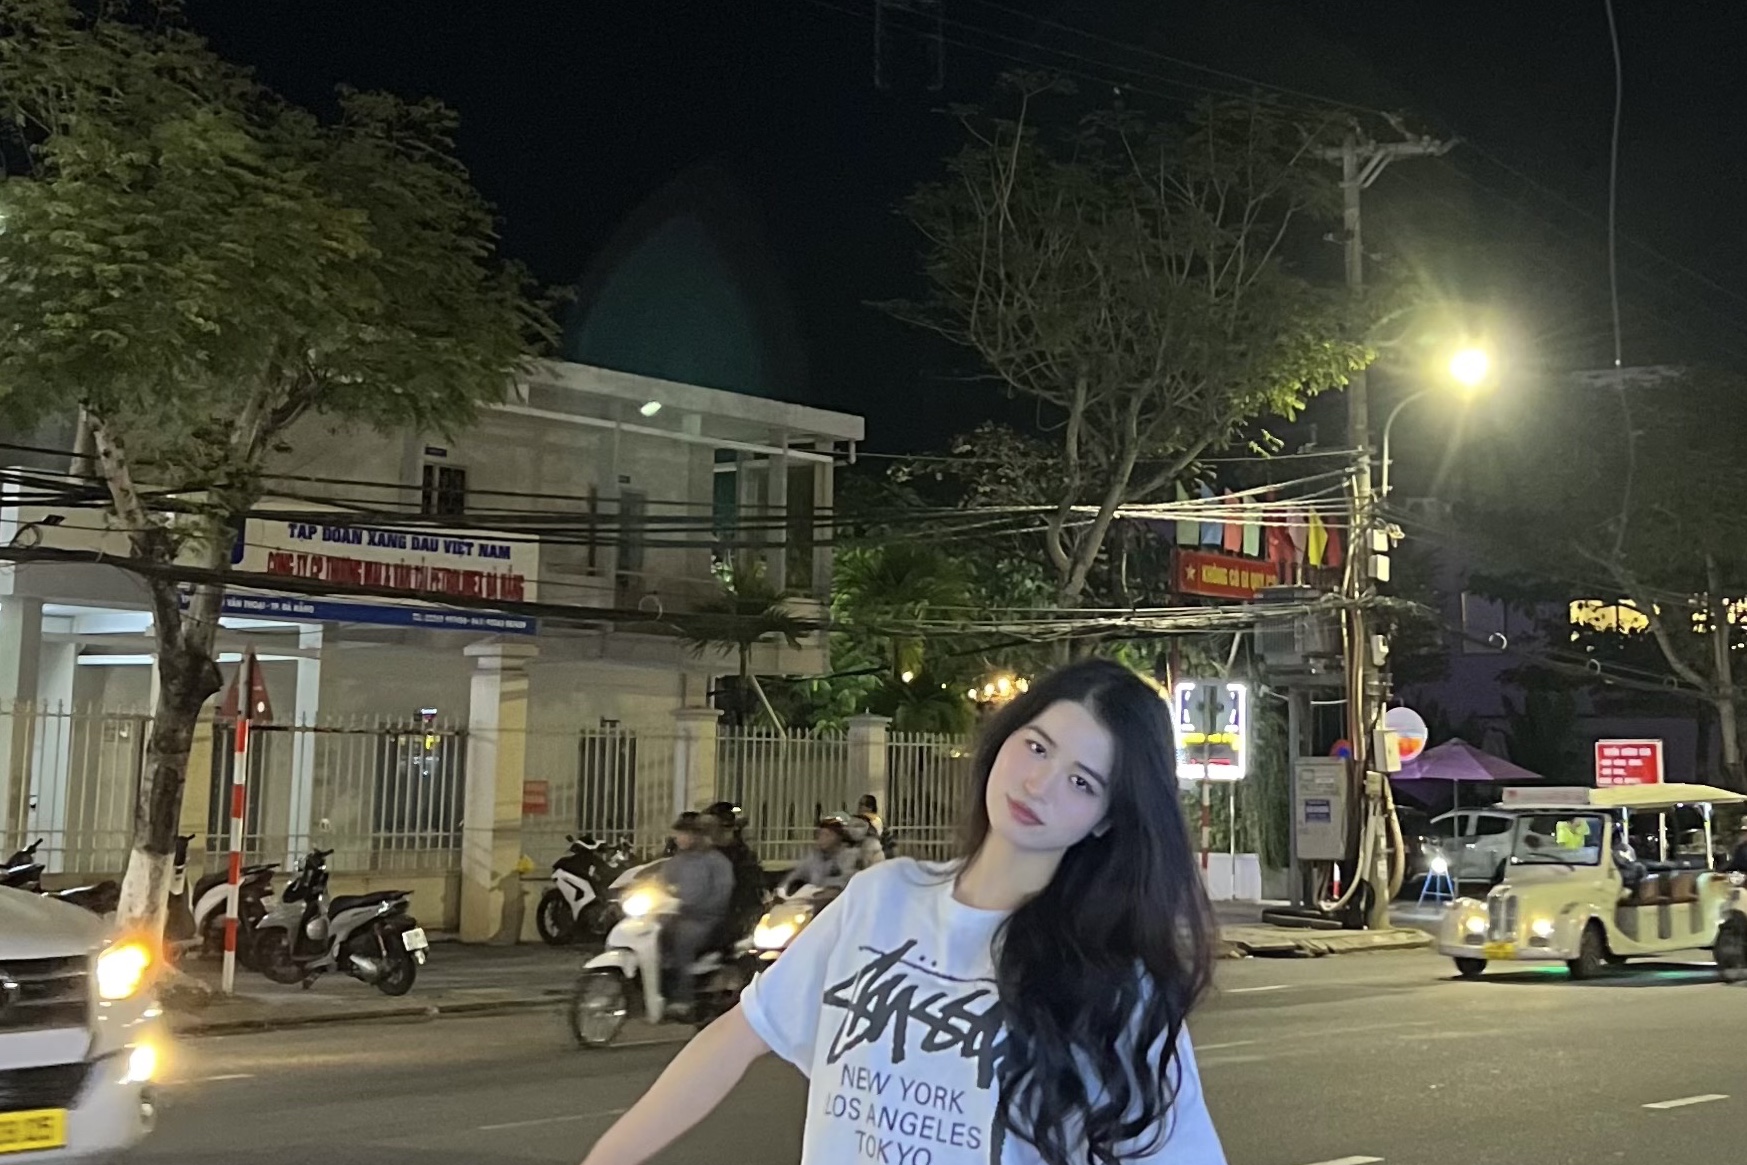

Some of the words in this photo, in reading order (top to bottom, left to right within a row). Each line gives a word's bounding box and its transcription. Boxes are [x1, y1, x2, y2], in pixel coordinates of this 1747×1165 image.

[478, 542, 511, 560] NAM
[841, 1063, 892, 1095] NEW
[900, 1077, 965, 1115] YORK
[825, 1092, 861, 1121] LOS
[866, 1103, 982, 1150] ANGELES
